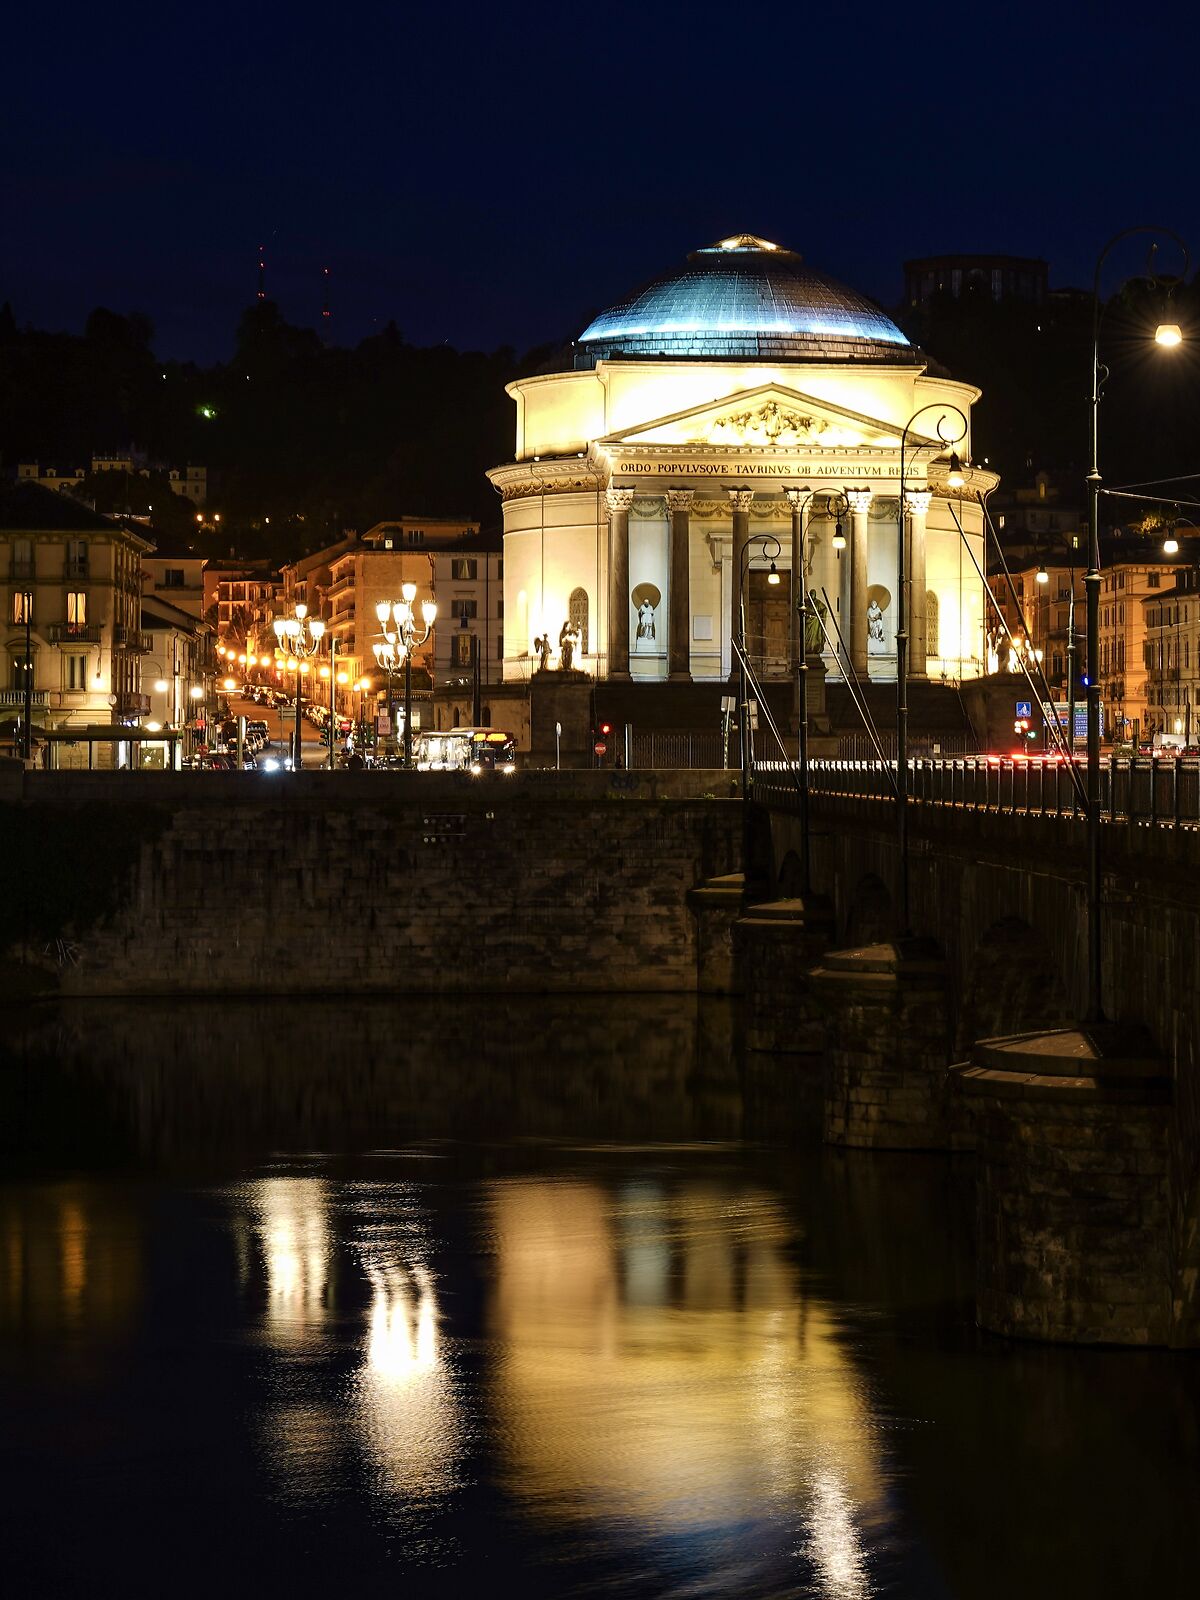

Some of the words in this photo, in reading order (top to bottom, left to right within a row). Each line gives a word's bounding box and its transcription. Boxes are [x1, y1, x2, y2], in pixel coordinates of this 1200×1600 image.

[620, 463, 652, 473] ORDO
[657, 463, 729, 475] POPVLVSQVE
[734, 464, 791, 475] TAVRINVS
[797, 465, 811, 475] OB
[816, 465, 882, 476] ADVENTVM
